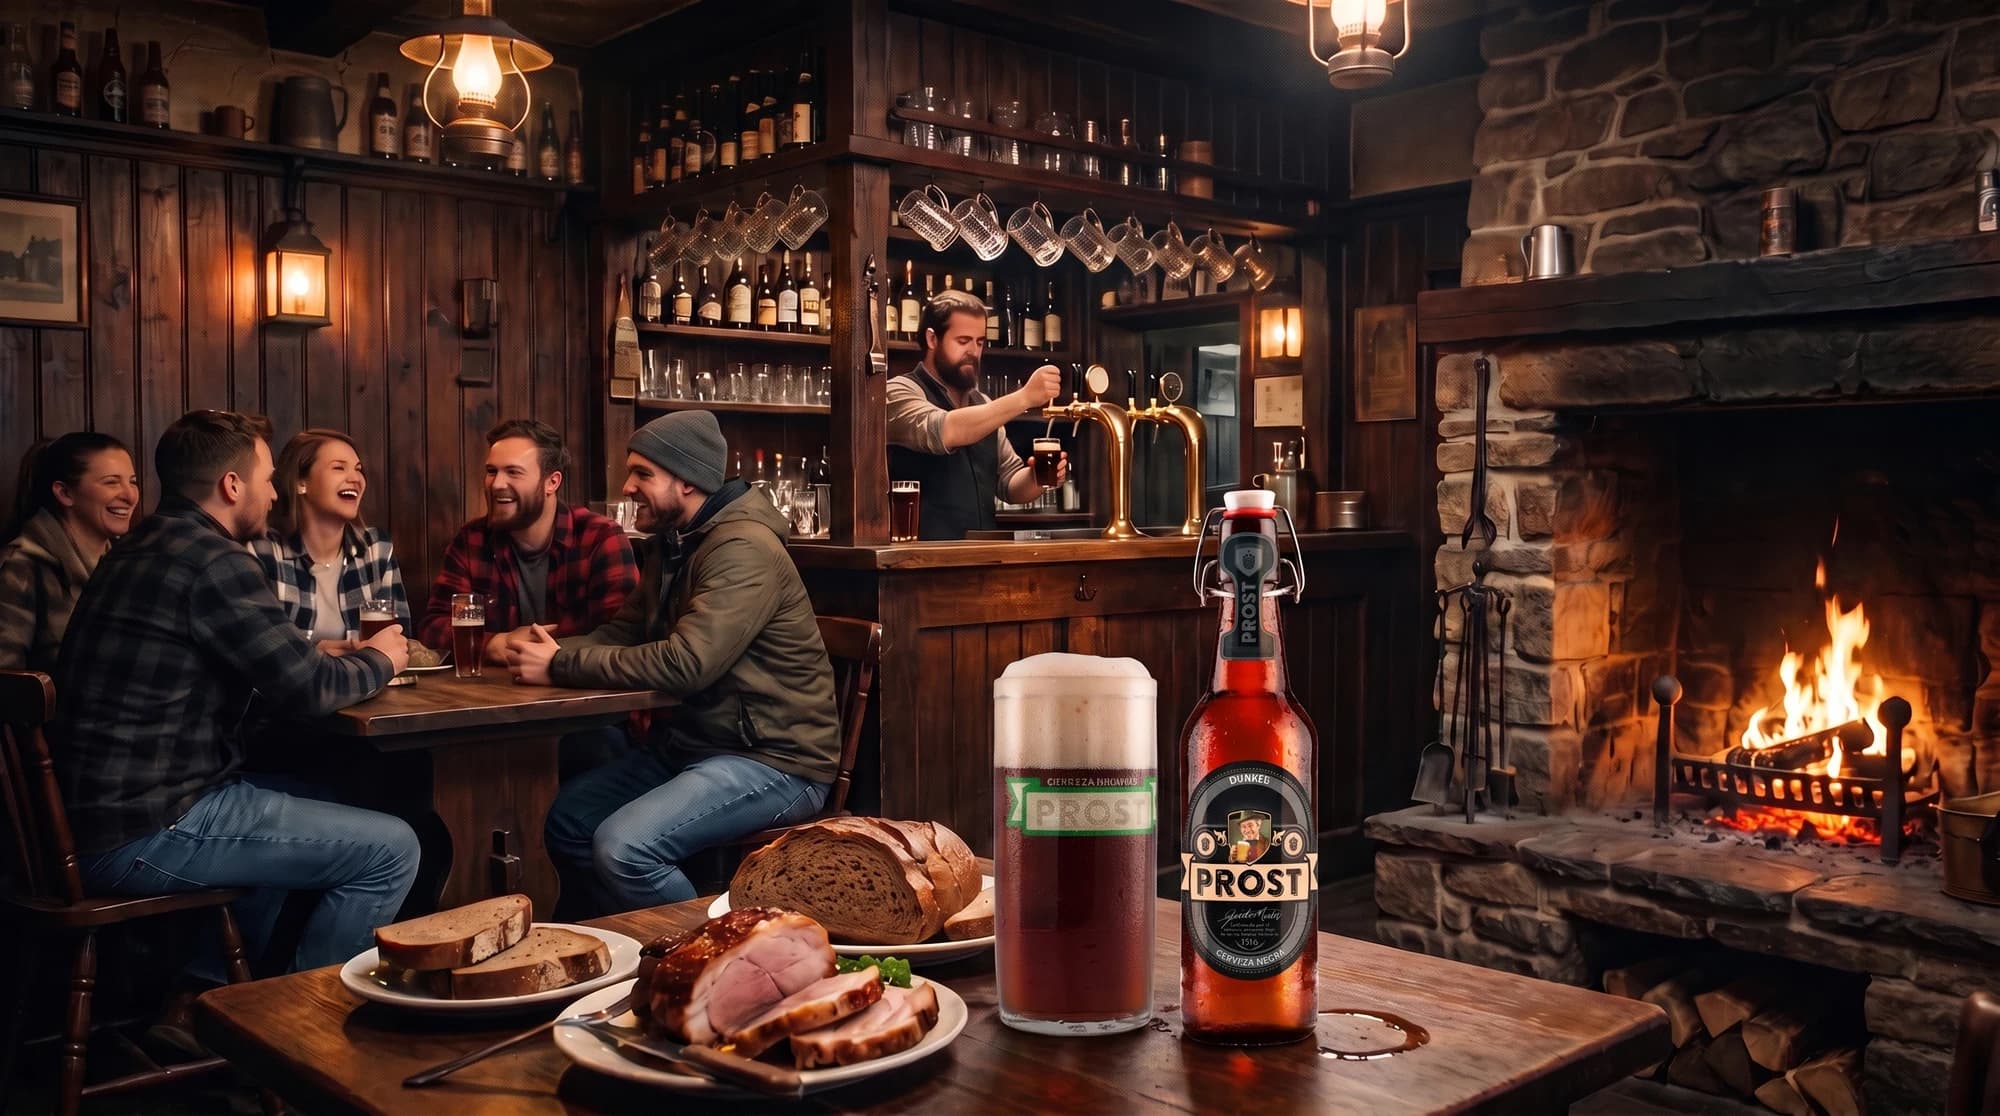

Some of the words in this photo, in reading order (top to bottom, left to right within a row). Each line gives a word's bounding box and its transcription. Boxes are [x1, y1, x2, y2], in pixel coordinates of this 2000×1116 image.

[1241, 582, 1257, 643] PROST
[1036, 798, 1146, 827] PROST
[1196, 868, 1303, 897] PROST
[1241, 938, 1259, 946] 1516
[1256, 949, 1285, 966] NEGRA
